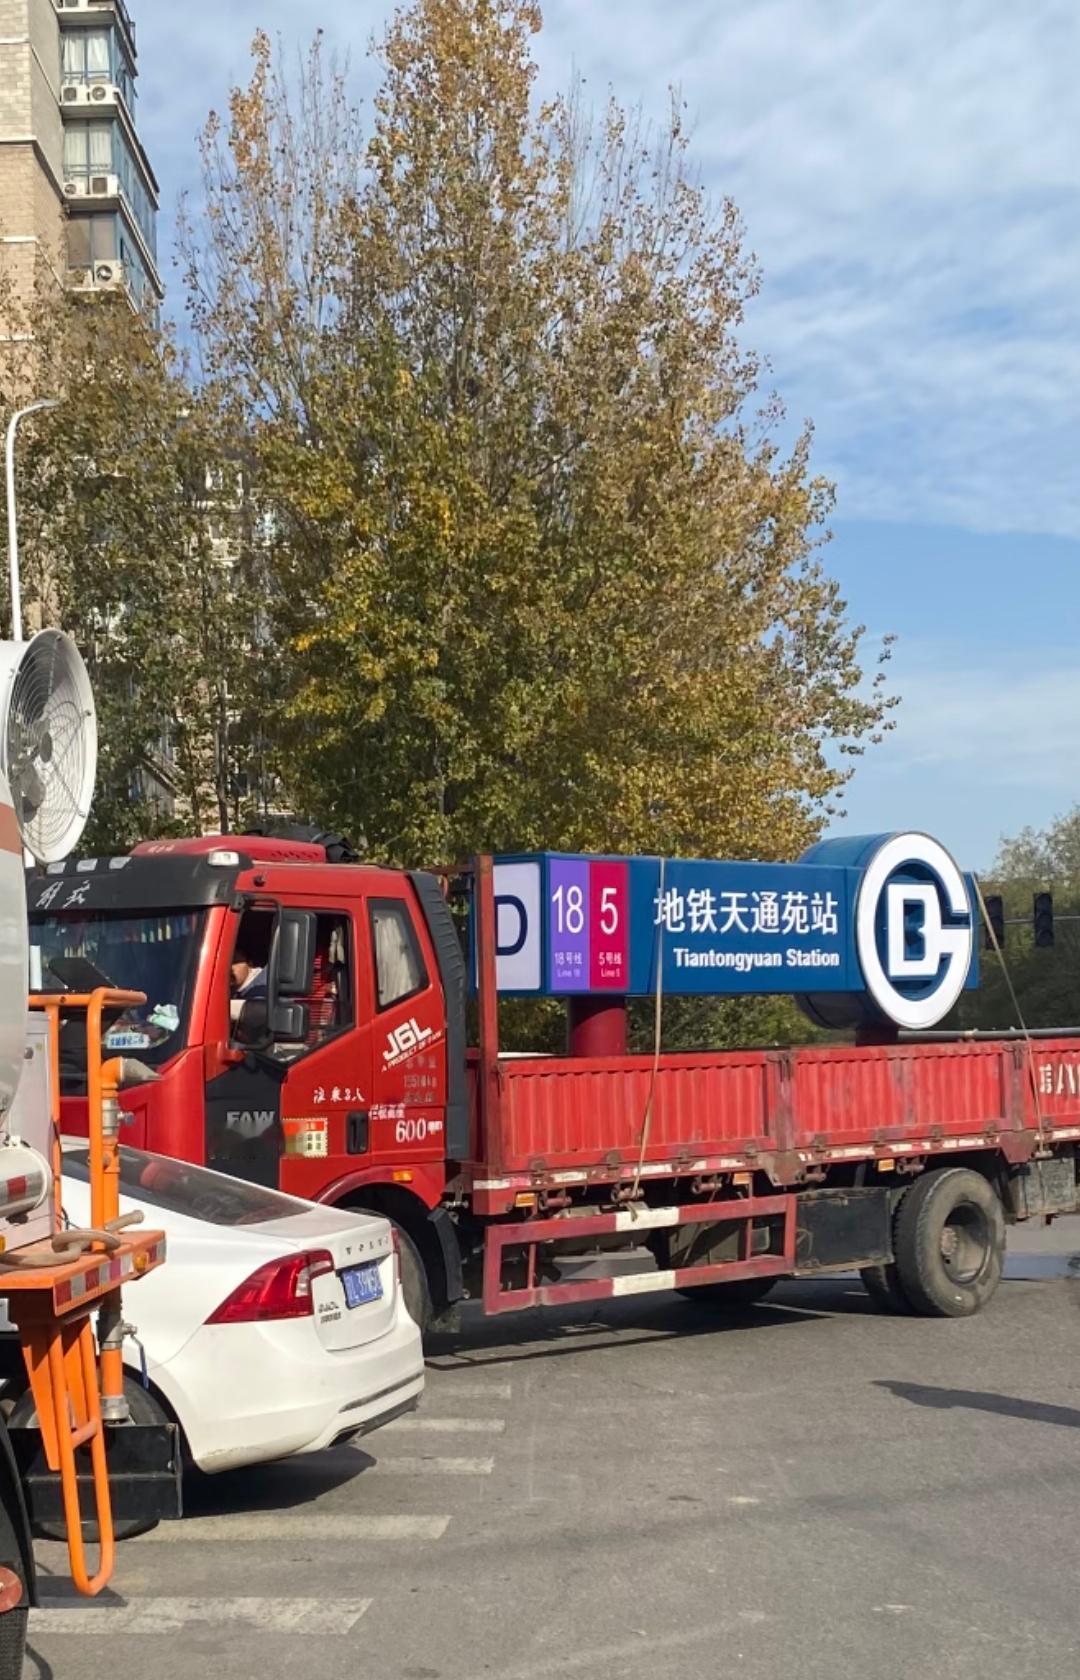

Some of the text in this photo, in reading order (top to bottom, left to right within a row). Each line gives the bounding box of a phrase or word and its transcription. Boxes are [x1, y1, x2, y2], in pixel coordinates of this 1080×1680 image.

[494, 894, 528, 956] D
[552, 885, 584, 934] 18
[600, 887, 619, 935] 5
[653, 887, 839, 935] 地铁天通苑站
[554, 952, 582, 965] 18号线
[598, 952, 622, 966] 5号线
[673, 948, 840, 972] Tiantongyuan Station
[226, 1111, 275, 1132] FAW
